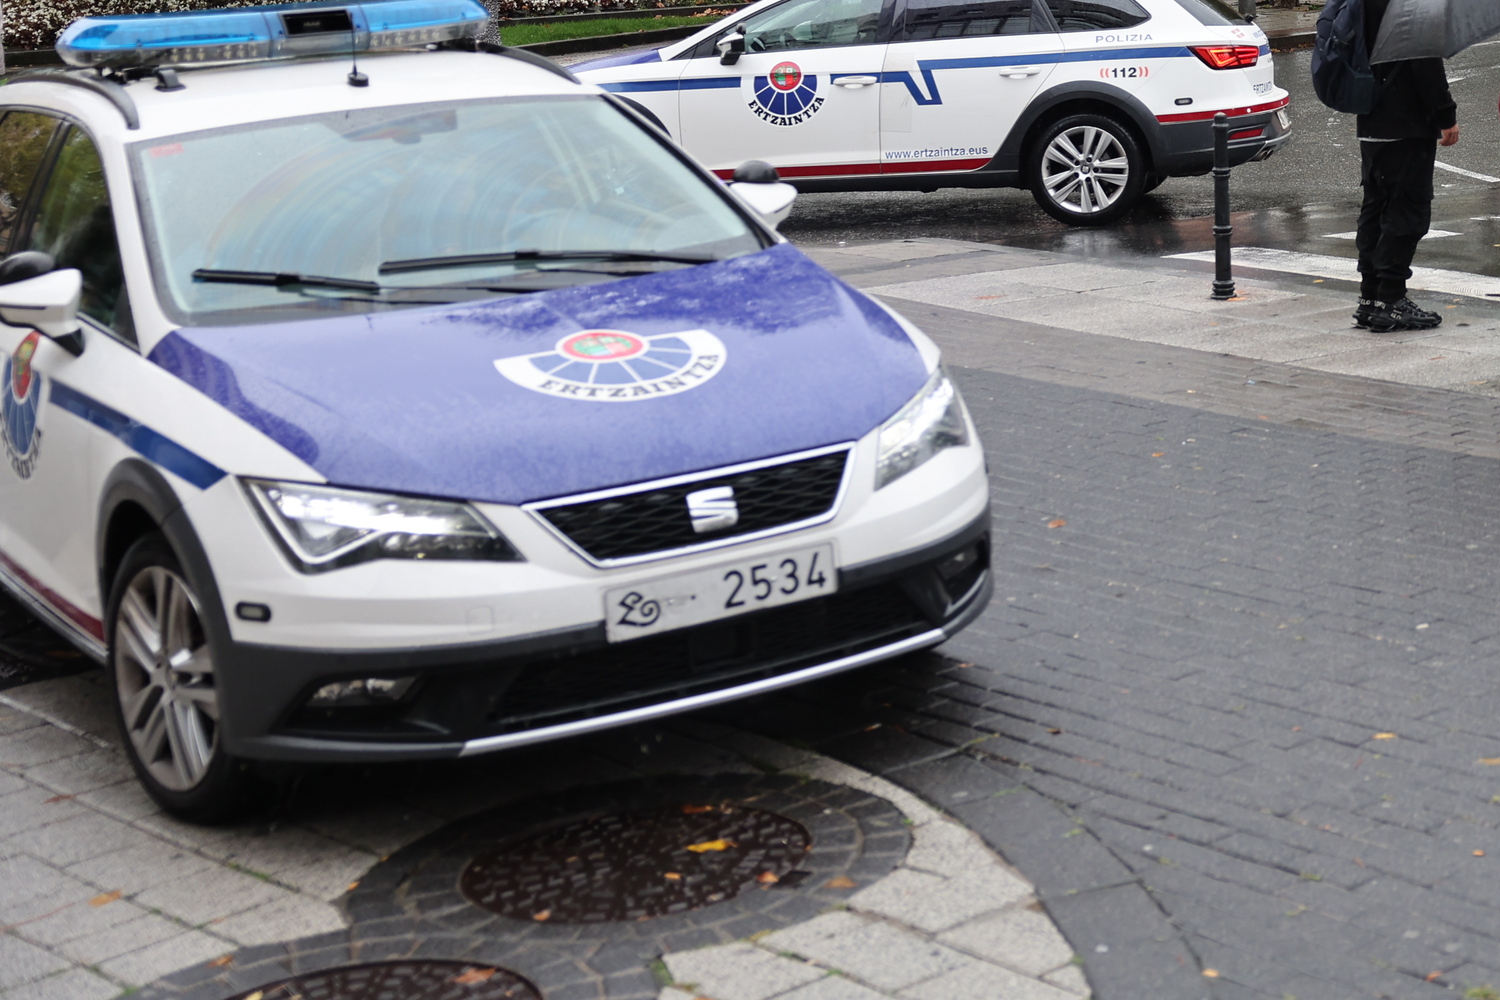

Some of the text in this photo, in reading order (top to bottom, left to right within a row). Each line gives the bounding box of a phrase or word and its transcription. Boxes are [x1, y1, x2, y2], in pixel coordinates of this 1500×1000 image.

[1095, 34, 1153, 44] POLIZIA
[1111, 67, 1137, 78] 112
[748, 96, 825, 127] ERTZAINTZA
[885, 146, 988, 160] www.ertzaintza.eus
[538, 354, 719, 398] ERTZAINTZA
[723, 552, 826, 609] 2534
